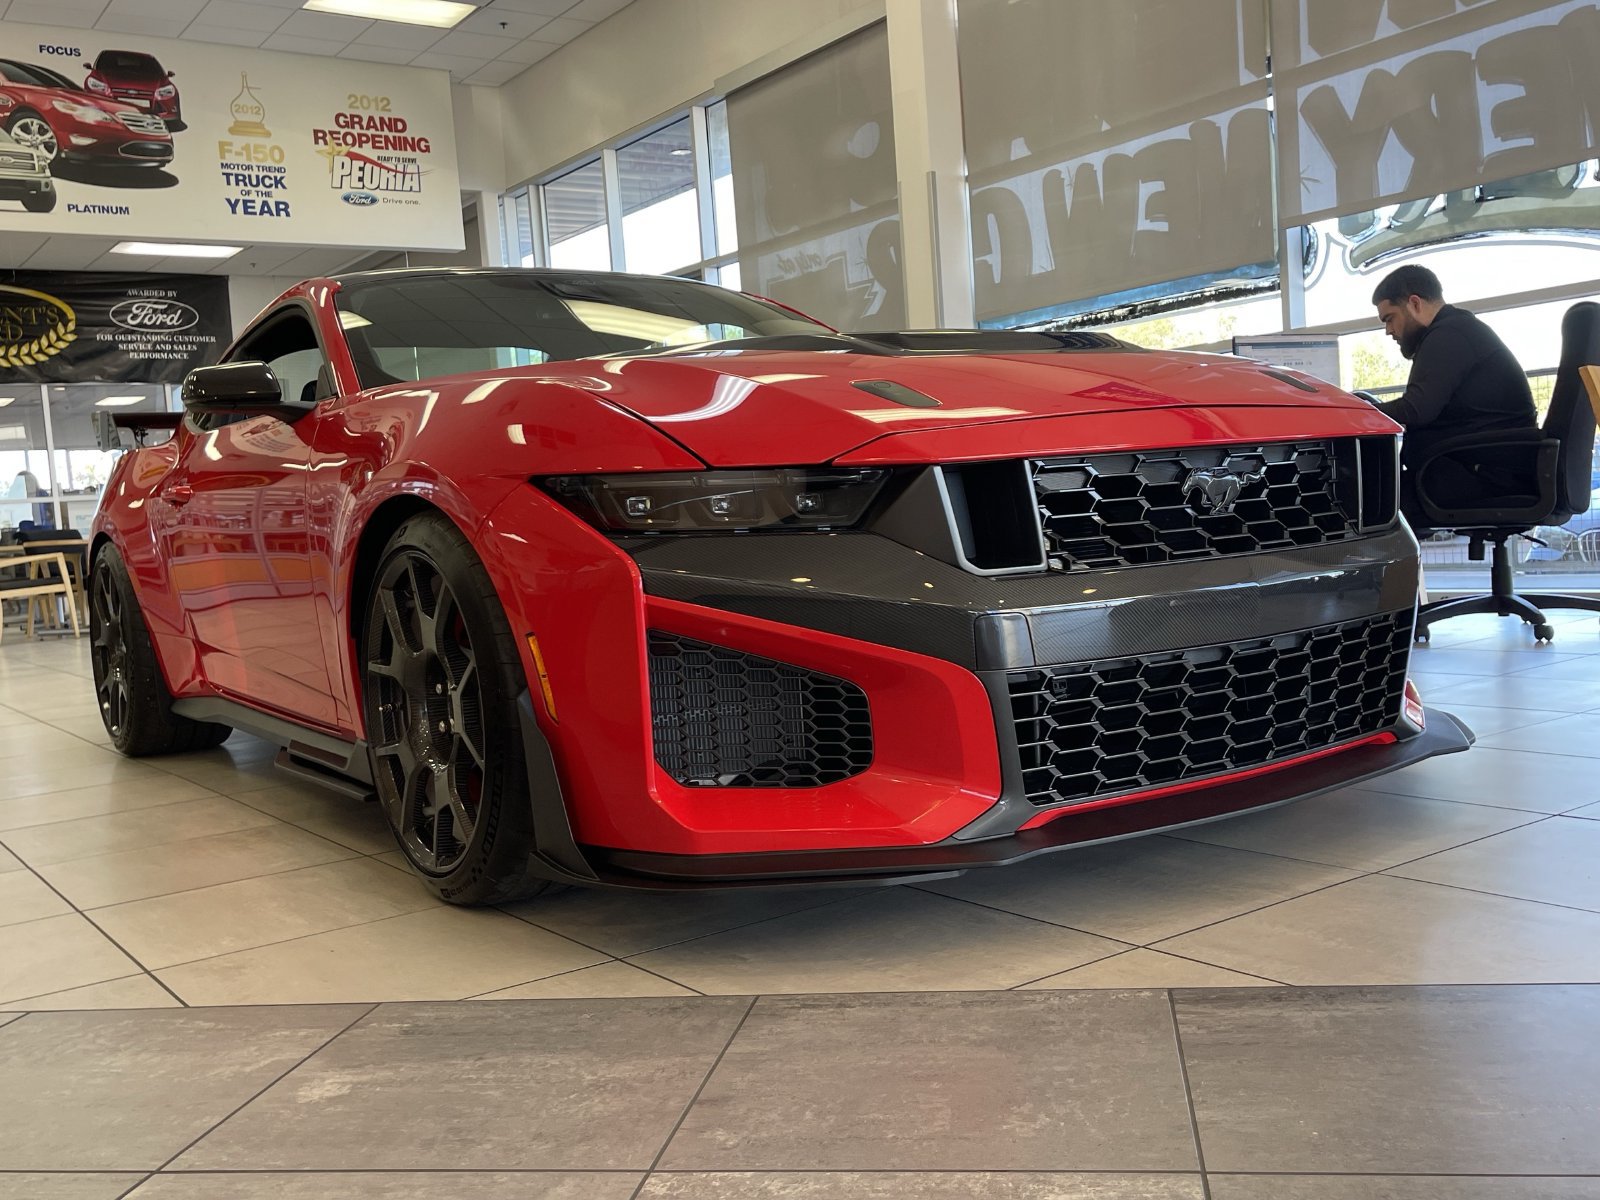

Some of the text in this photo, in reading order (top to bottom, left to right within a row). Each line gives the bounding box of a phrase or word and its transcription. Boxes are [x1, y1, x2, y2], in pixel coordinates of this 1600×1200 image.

[39, 44, 81, 57] FOCUS
[234, 103, 261, 115] 2012
[347, 94, 391, 112] 2012
[334, 112, 407, 133] GRAND
[312, 129, 431, 153] REOPENING
[218, 140, 285, 164] F-150
[220, 162, 286, 174] MOTOR TREND
[331, 155, 421, 192] PEORIA
[222, 172, 287, 190] TRUCK
[240, 189, 273, 198] OF THE
[382, 197, 403, 205] Drive
[67, 203, 130, 215] PLATINUM
[225, 198, 291, 217] YEAR
[127, 289, 178, 298] AWARDED BY
[127, 302, 182, 326] Ford
[96, 334, 216, 343] FOR OUTSTANDING CUSTOMER
[118, 343, 153, 352] SERVICE
[173, 344, 198, 352] SALES
[129, 351, 190, 360] PERFORMANCE
